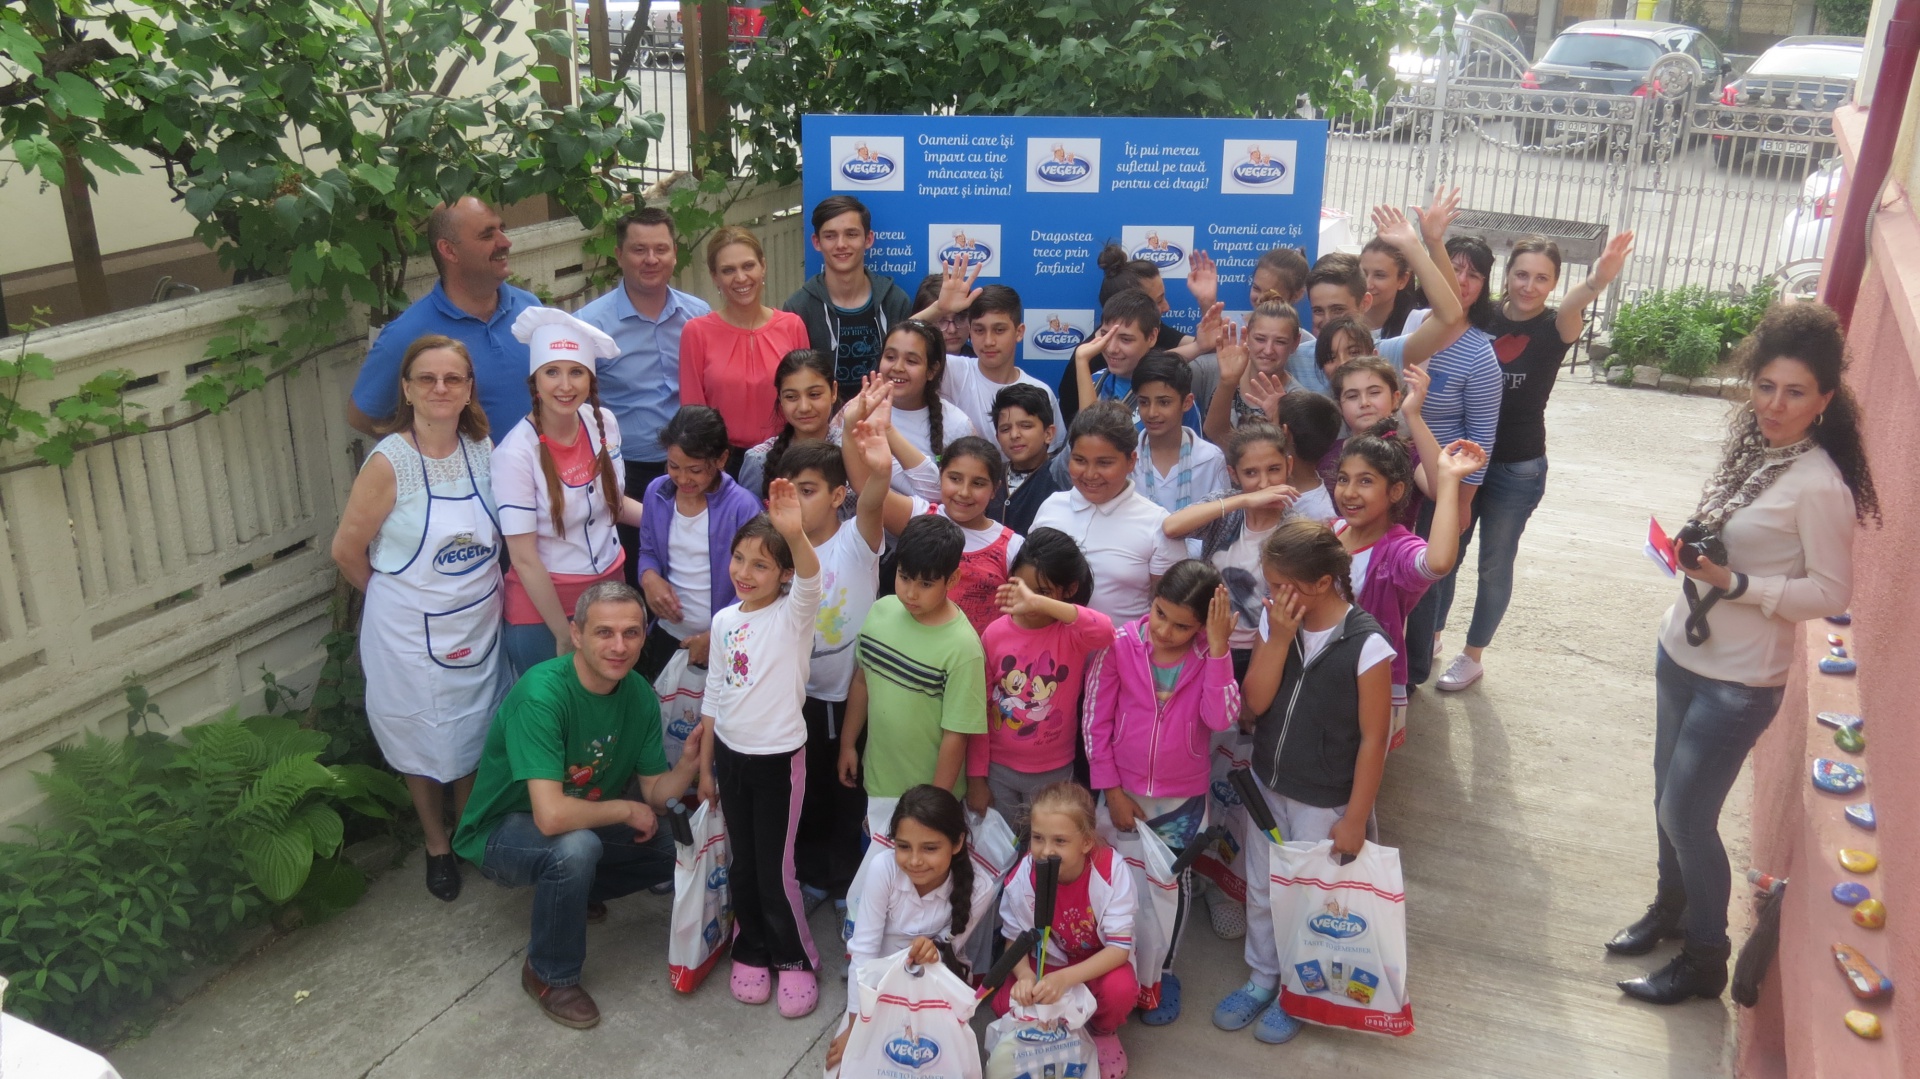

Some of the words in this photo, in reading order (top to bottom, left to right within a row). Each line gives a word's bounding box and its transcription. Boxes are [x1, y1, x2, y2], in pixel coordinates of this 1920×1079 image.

[918, 133, 970, 146] Oamenii
[971, 136, 999, 146] care
[924, 150, 965, 165] împart
[968, 153, 983, 163] cu
[984, 151, 1008, 163] tine
[1140, 144, 1160, 158] pui
[1162, 146, 1200, 156] mereu
[845, 163, 891, 174] VEGETA
[928, 167, 988, 179] mâncarea
[1041, 165, 1086, 176] VEGETA
[1116, 160, 1160, 175] sufletul
[1162, 163, 1178, 175] pe
[1179, 161, 1207, 173] tavă
[1236, 166, 1281, 177] VEGETA
[918, 183, 960, 198] împart
[973, 184, 1012, 196] inima!
[1111, 179, 1152, 191] pentru
[1153, 177, 1171, 189] cei
[1172, 177, 1209, 192] dragi!
[1208, 223, 1259, 235] Oamenii
[1260, 226, 1287, 235] care
[1031, 230, 1094, 244] Dragostea
[869, 247, 884, 258] pe
[886, 245, 913, 256] tavă
[1033, 248, 1063, 258] trece
[1064, 246, 1091, 260] prin
[1213, 239, 1254, 253] împart
[1255, 242, 1272, 251] cu
[1135, 252, 1179, 262] VEGETA
[1216, 255, 1257, 267] mânca
[880, 261, 917, 275] dragi!
[1034, 261, 1085, 276] farfurie!
[1037, 334, 1081, 345] VEGETA
[438, 545, 491, 566] VEGETA
[1312, 918, 1362, 932] VEGETA
